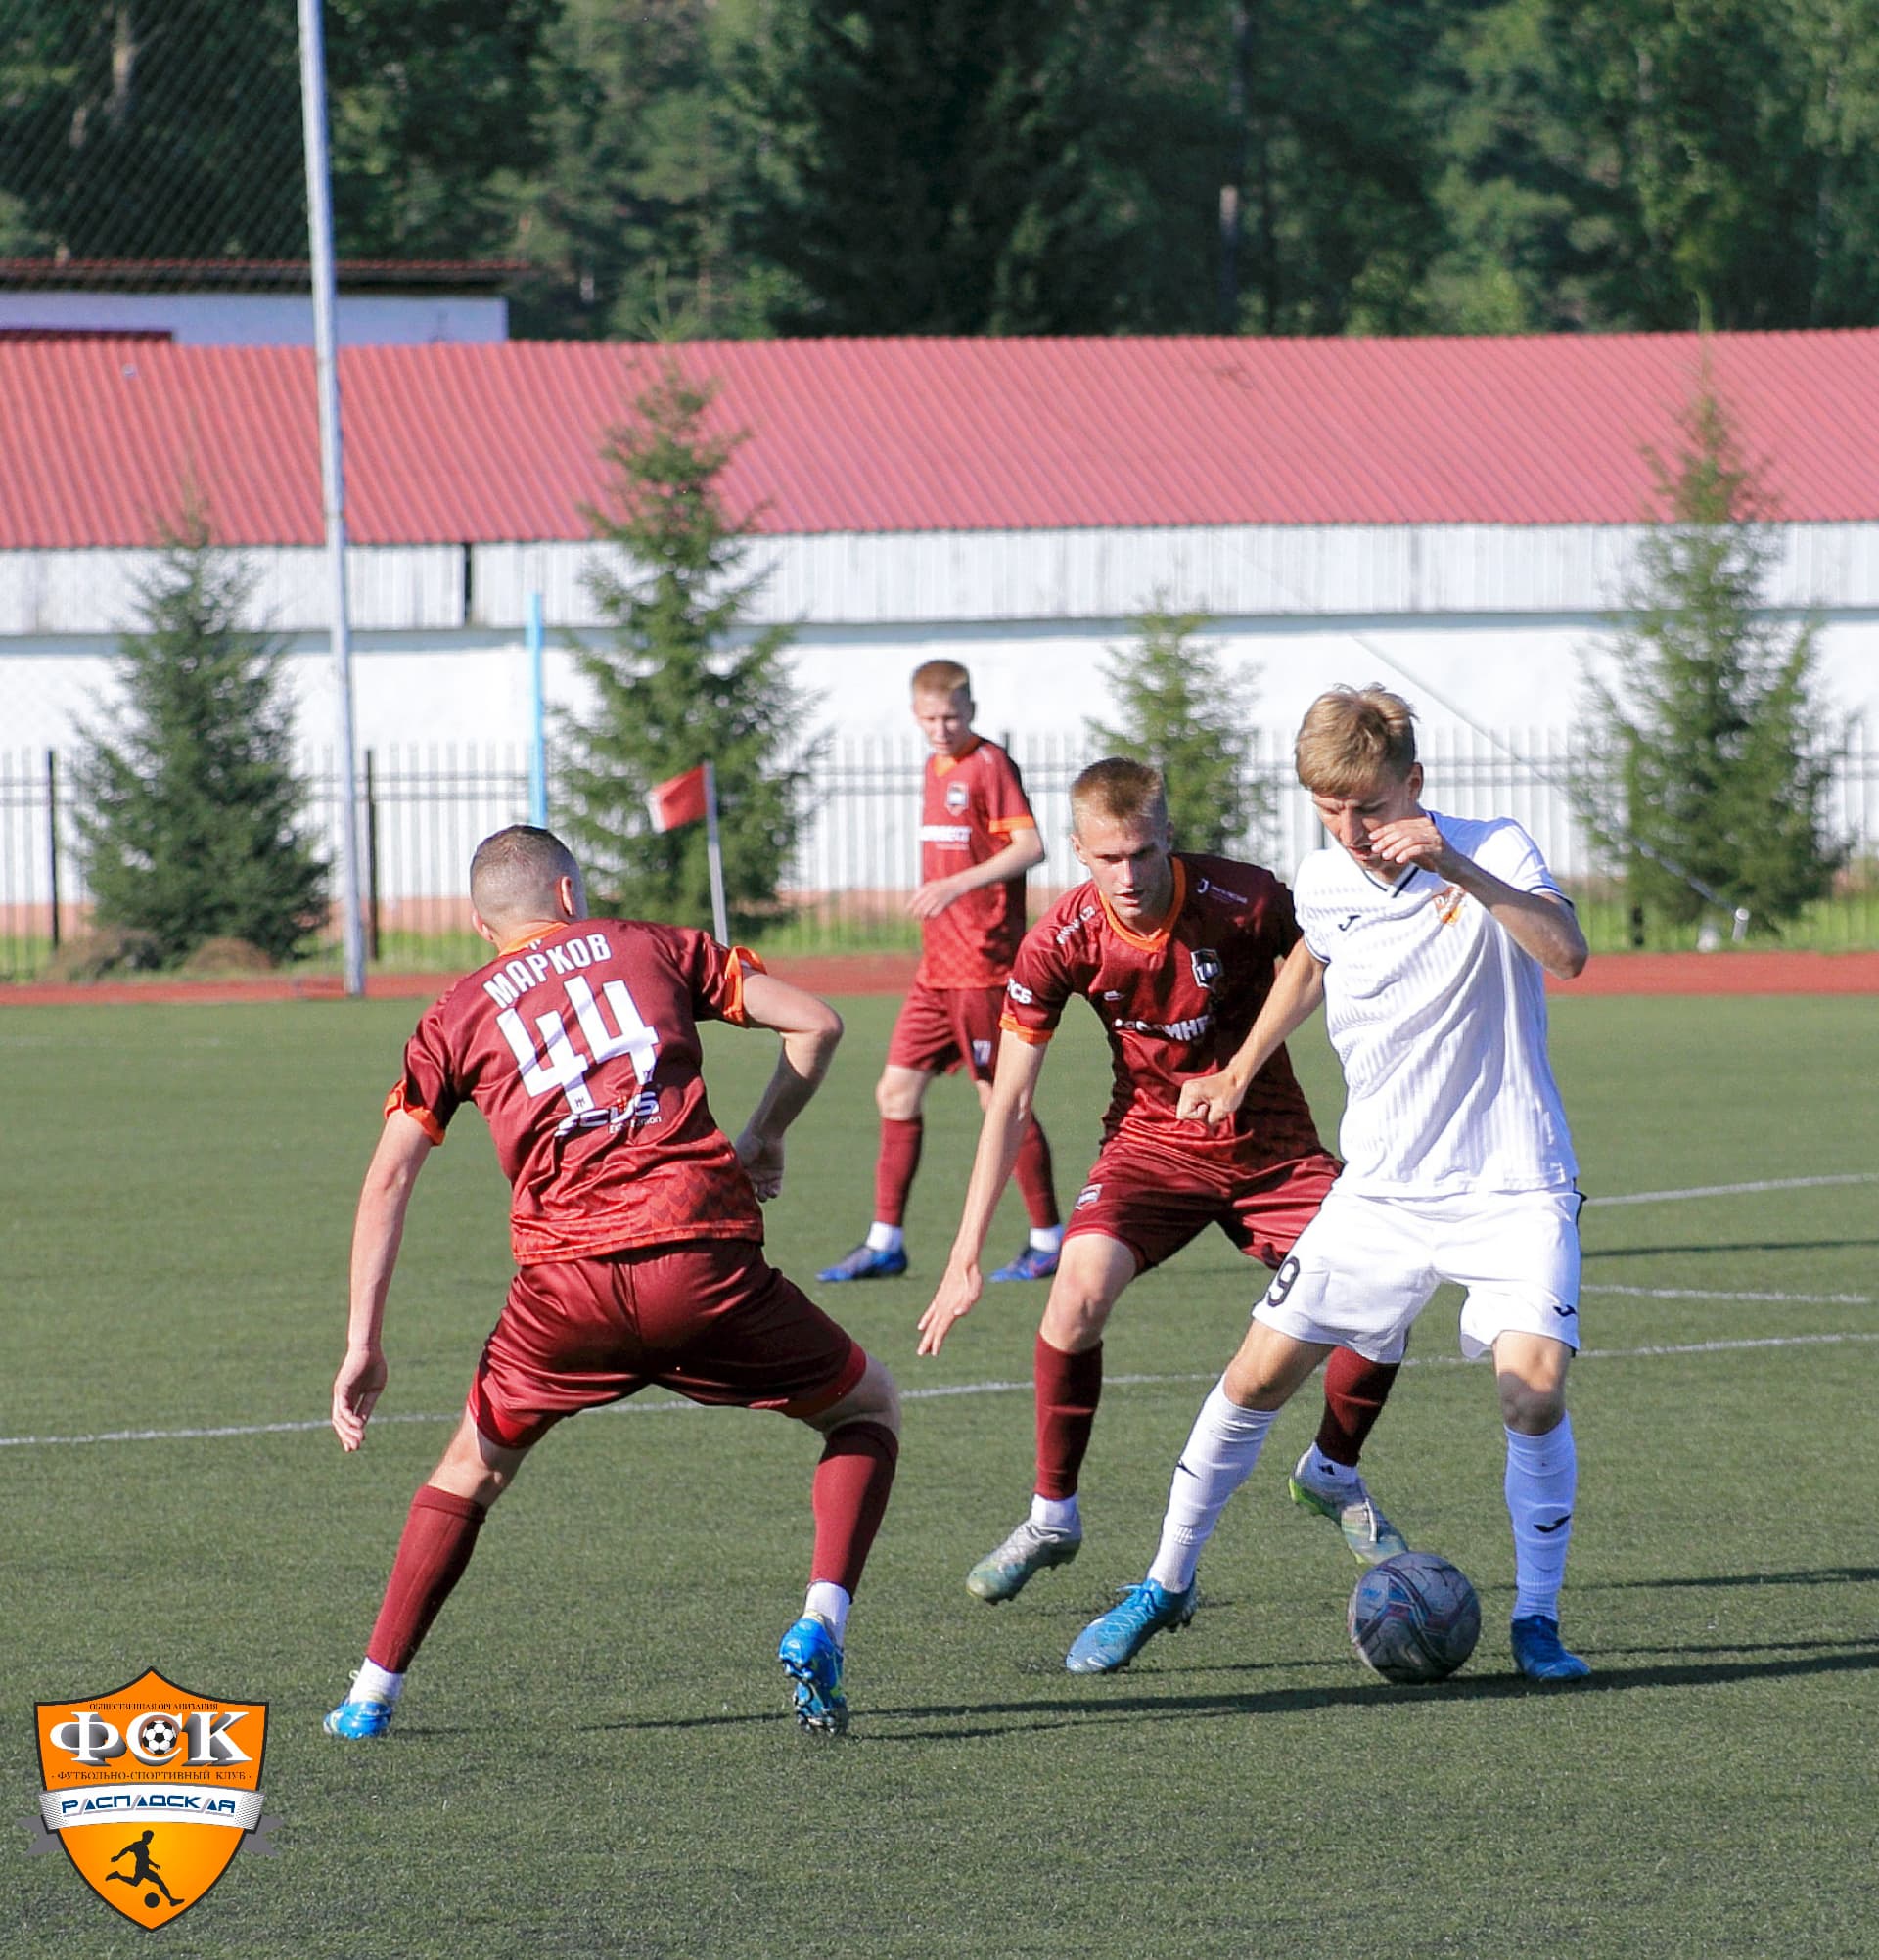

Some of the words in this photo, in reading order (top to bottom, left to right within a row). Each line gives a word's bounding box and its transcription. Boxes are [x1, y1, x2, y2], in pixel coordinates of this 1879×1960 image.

[483, 934, 612, 1009] МАРКОВ
[496, 975, 660, 1112] 44
[1268, 1256, 1300, 1307] 9
